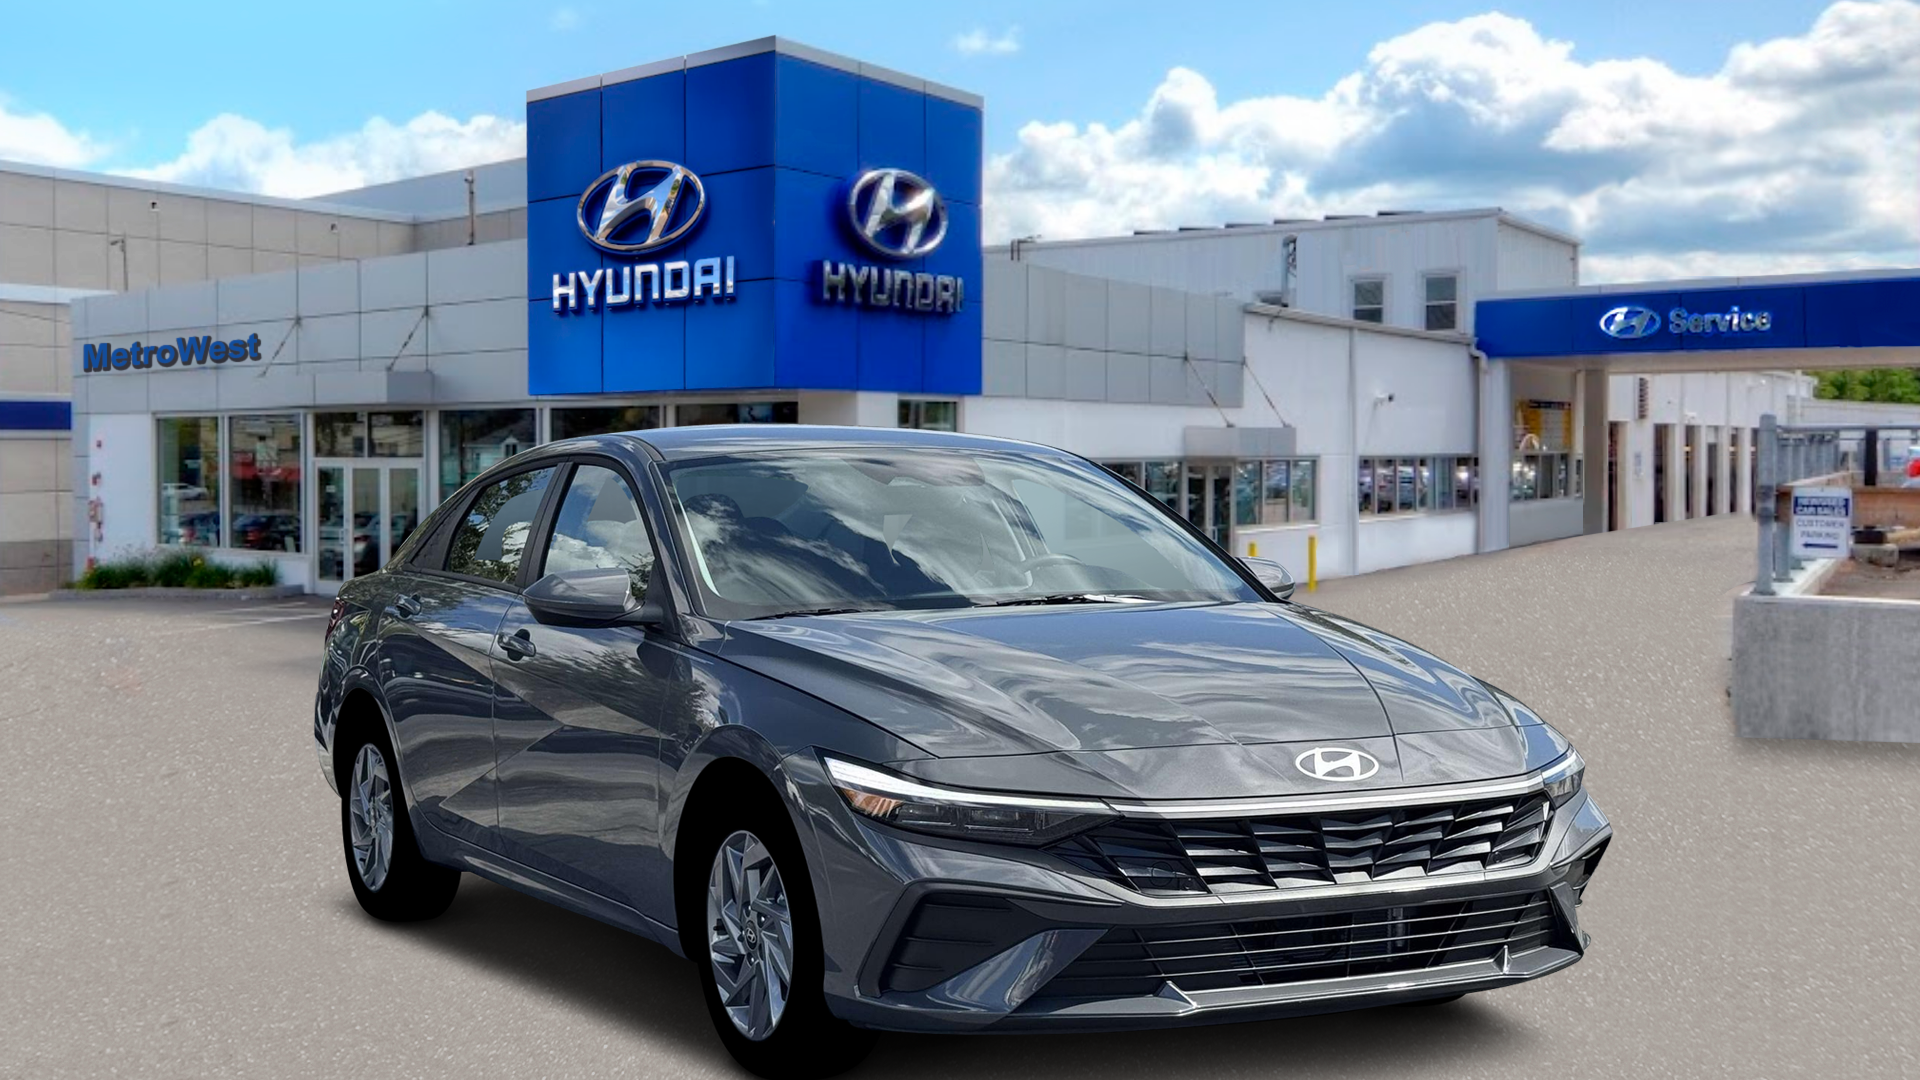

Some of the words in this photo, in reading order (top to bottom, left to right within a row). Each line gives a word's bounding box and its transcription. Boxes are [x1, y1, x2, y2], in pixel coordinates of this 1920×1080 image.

[553, 256, 735, 309] HYUNDAI
[823, 260, 964, 313] HYUNDAI
[1669, 306, 1771, 333] Service
[83, 333, 261, 373] MetroWest
